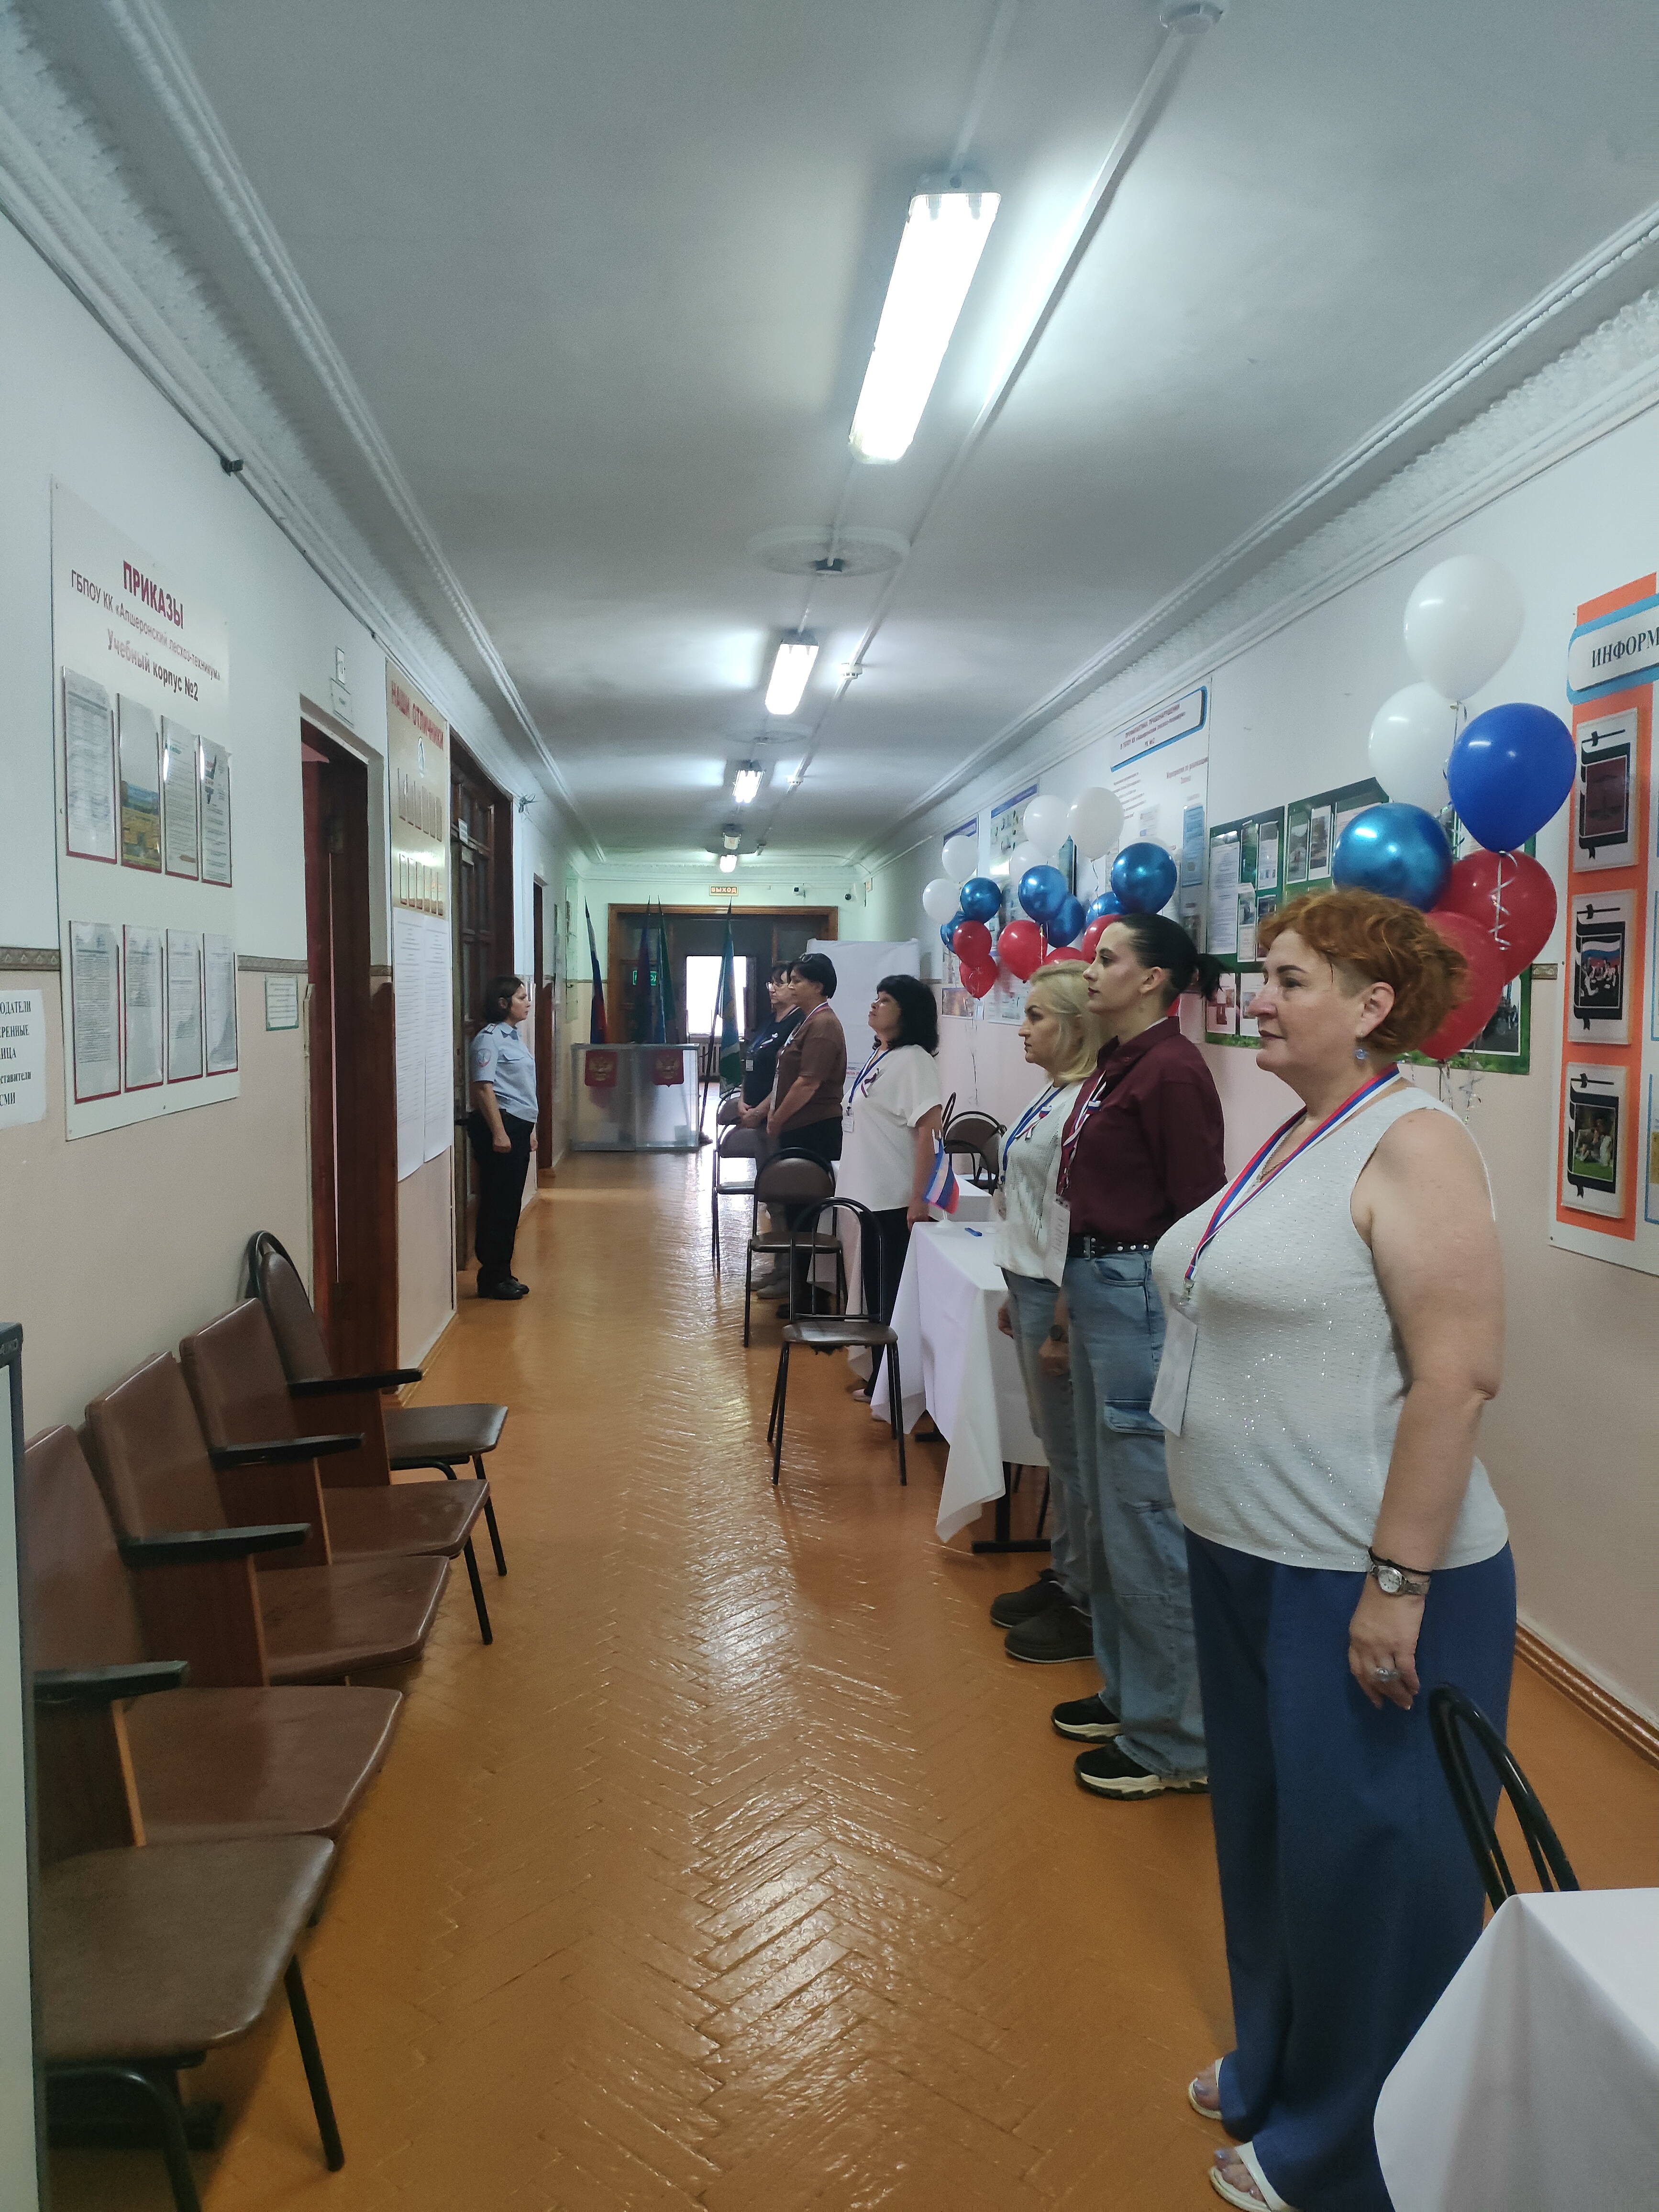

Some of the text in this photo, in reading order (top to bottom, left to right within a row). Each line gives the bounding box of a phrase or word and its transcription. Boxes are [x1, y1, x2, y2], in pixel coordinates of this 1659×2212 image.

[72, 569, 101, 603] ГБПОУ
[103, 591, 113, 612] КК
[123, 560, 183, 629] ПРИКАЗЫ
[108, 628, 198, 701] Учебный корпус №2
[0, 1047, 16, 1060] ИЦА
[0, 1072, 31, 1084] ставители
[0, 1092, 15, 1106] СМИ
